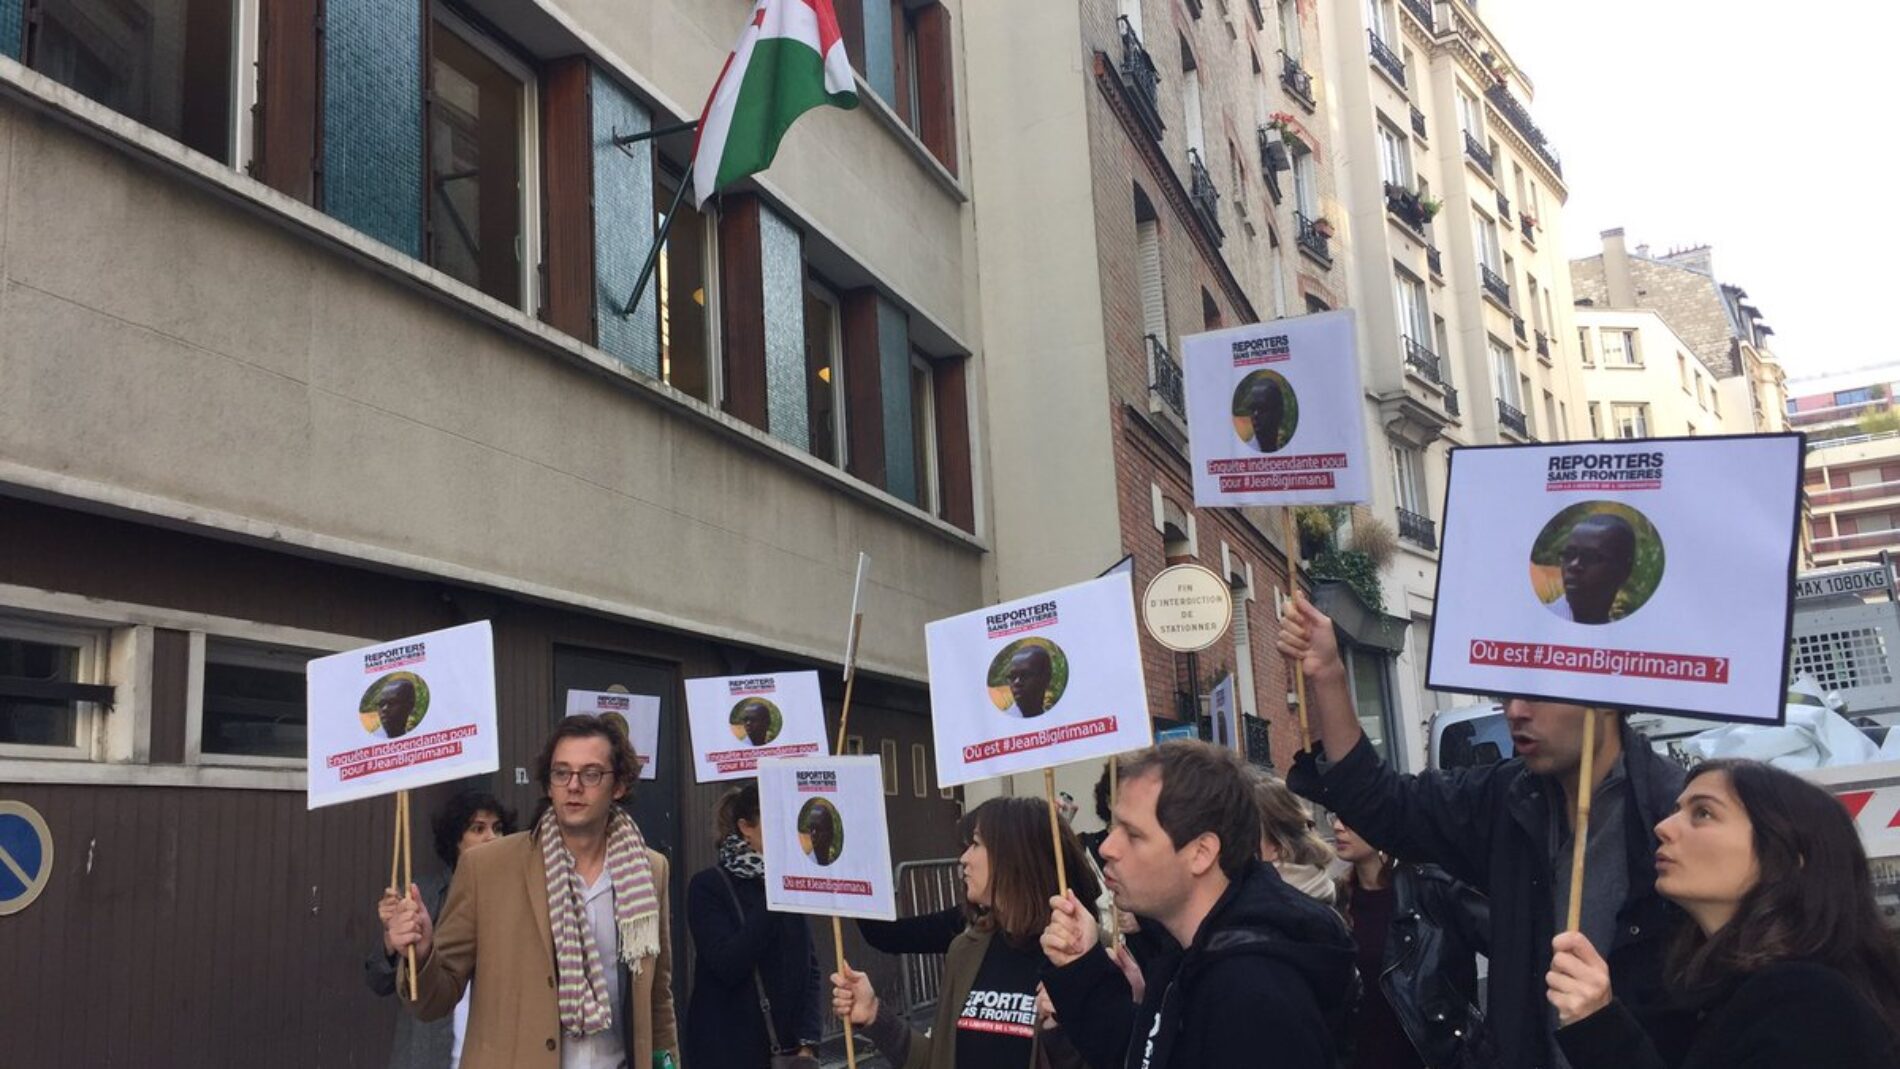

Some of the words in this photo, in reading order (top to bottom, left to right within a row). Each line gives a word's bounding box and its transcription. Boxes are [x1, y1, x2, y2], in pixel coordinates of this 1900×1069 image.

[1232, 335, 1288, 351] REPORTERS
[1209, 460, 1246, 473] Enquête
[1248, 457, 1318, 473] indépendante
[1321, 457, 1345, 469] pour
[1548, 452, 1664, 470] REPORTERS
[1222, 478, 1241, 488] pour
[1244, 474, 1327, 489] #JeanBigirimana
[1548, 471, 1577, 481] SANS
[1581, 469, 1662, 480] FRONTIERES
[1177, 584, 1193, 592] FIN
[1794, 580, 1823, 597] MAX
[986, 600, 1057, 625] REPORTERS
[988, 623, 1008, 632] SANS
[1160, 622, 1217, 633] STATIONNER
[364, 643, 425, 661] REPORTERS
[1472, 641, 1497, 661] Où
[1503, 646, 1530, 663] est
[1533, 646, 1707, 677] #JeanBigirimana
[1714, 659, 1726, 679] ?
[371, 732, 448, 756] indépendante
[450, 727, 476, 741] pour
[964, 744, 983, 760] Où
[985, 742, 1000, 754] est
[1003, 722, 1106, 750] #JeanBigirimana
[1108, 716, 1115, 730] ?
[341, 764, 365, 778] pour
[367, 747, 455, 771] #JeanBigirimana
[796, 771, 836, 780] REPORTERS
[965, 991, 1037, 1012] EPORTE
